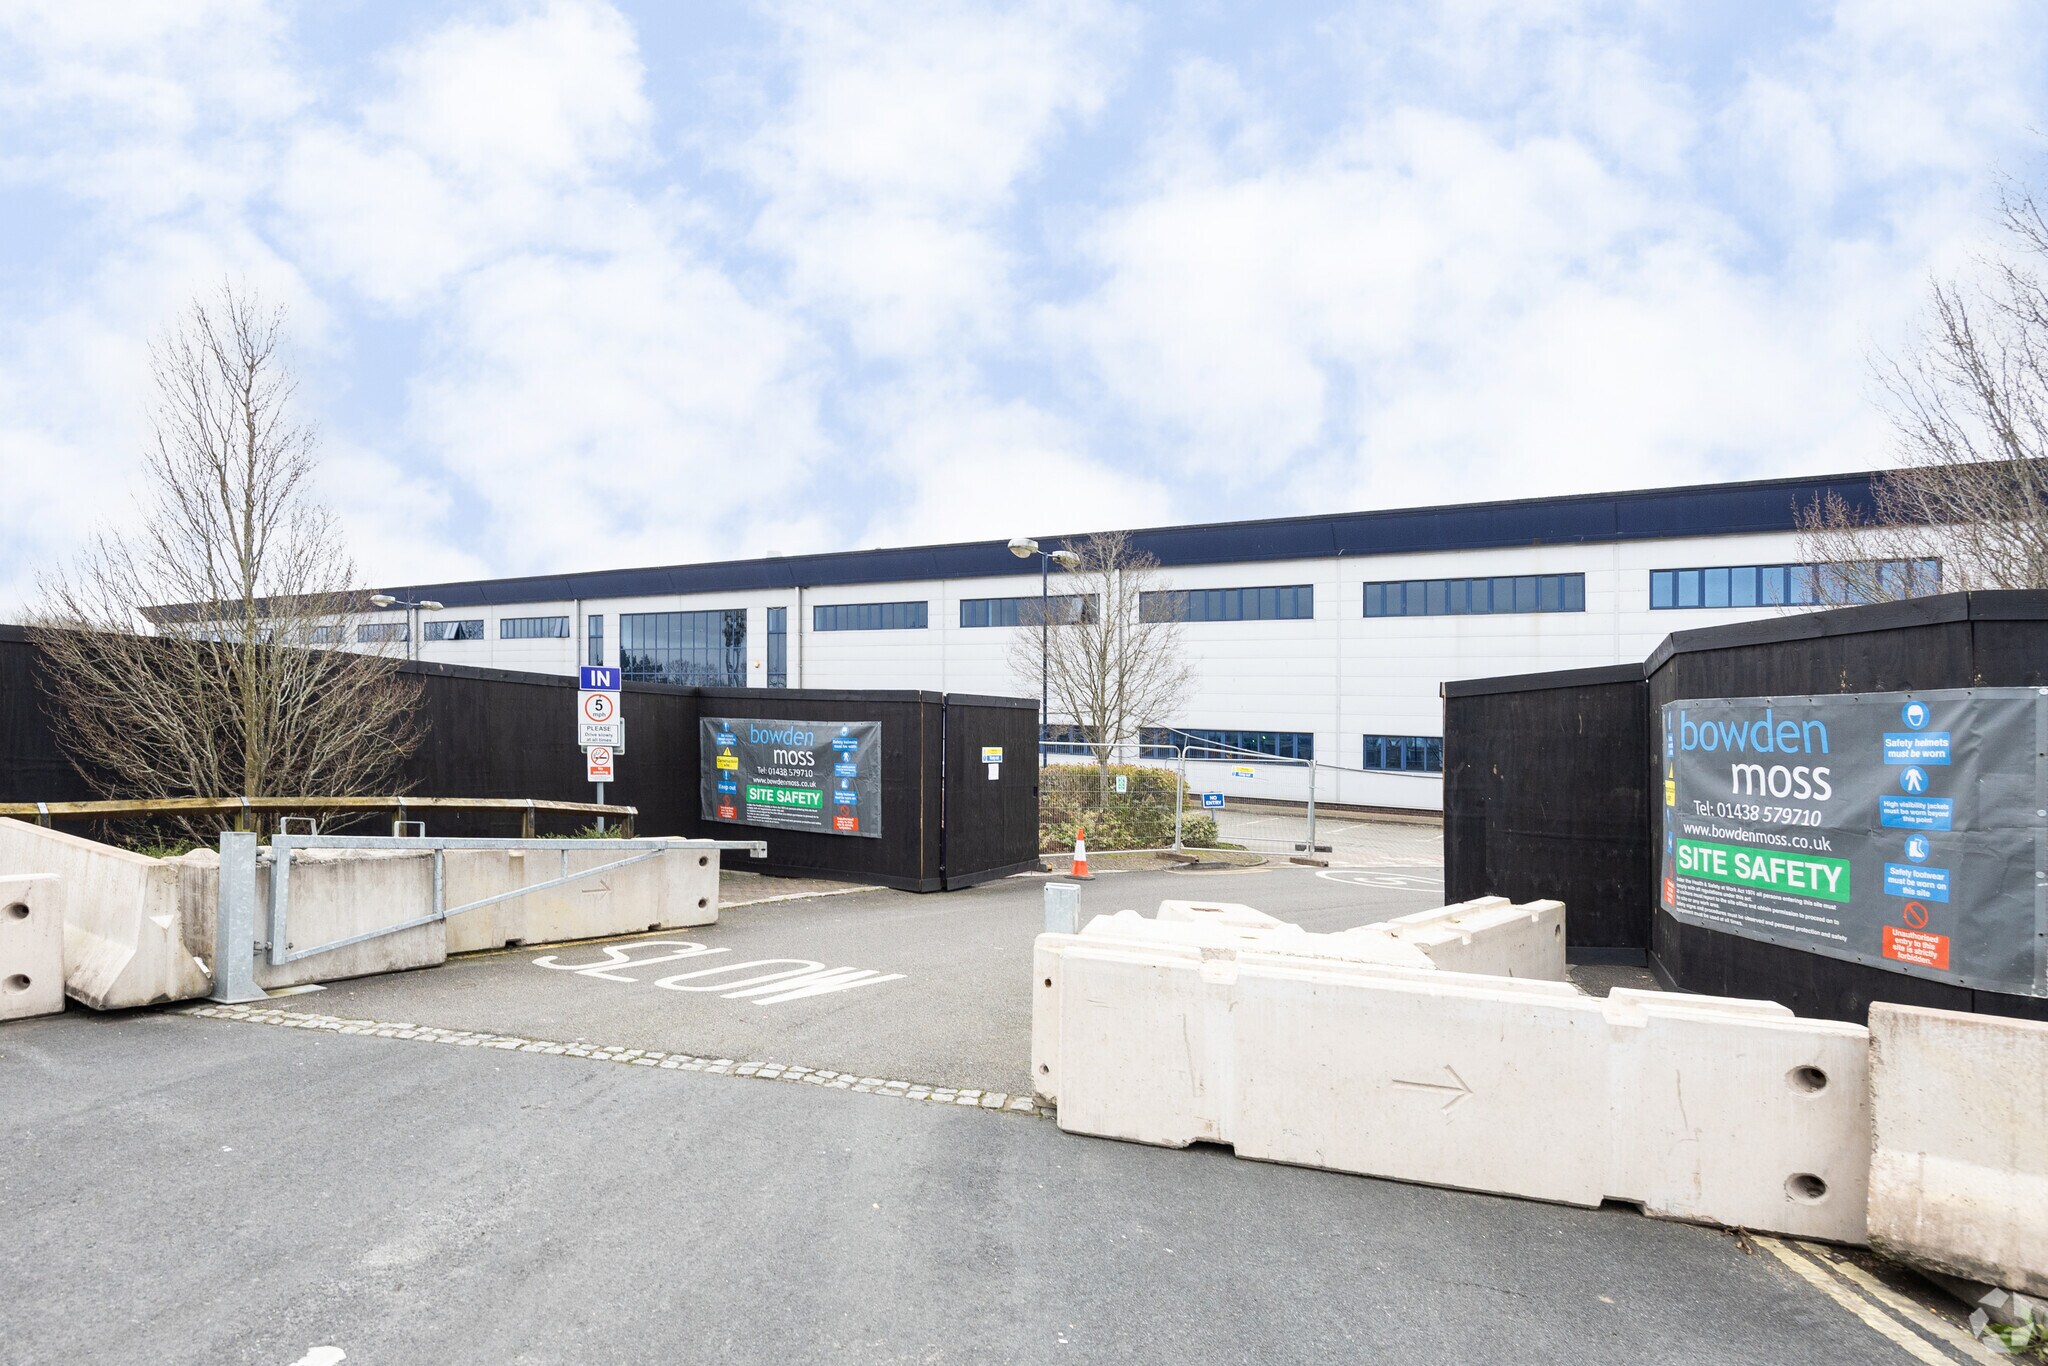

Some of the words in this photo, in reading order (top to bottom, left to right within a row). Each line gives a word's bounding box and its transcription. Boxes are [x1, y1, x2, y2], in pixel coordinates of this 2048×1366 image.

[591, 670, 610, 687] IN
[595, 699, 603, 711] 5
[750, 724, 814, 746] bowden
[1680, 708, 1829, 754] bowden
[1886, 738, 1912, 749] Safety
[1915, 738, 1949, 747] helmets
[774, 749, 815, 766] moss
[757, 766, 767, 774] Tel:
[768, 767, 787, 775] 01438
[789, 769, 813, 777] 579710
[753, 777, 816, 788] www.bowdenmoss.co.uk
[1731, 763, 1832, 801] moss
[749, 788, 773, 801] SITE
[778, 790, 820, 805] SAFETY
[1693, 800, 1714, 817] Tel:
[1717, 802, 1760, 821] 01438
[1762, 806, 1822, 827] 579710
[1683, 823, 1832, 852] www.bowdenmoss.co.uk
[1678, 845, 1728, 876] SITE
[1734, 852, 1843, 893] SAFETY
[1890, 867, 1912, 878] Safety
[1913, 870, 1944, 880] footwear
[1903, 887, 1915, 895] this
[1916, 889, 1930, 897] site
[1892, 929, 1938, 943] Unauthorised
[1895, 938, 1913, 946] entry
[532, 940, 908, 1005] SLOW
